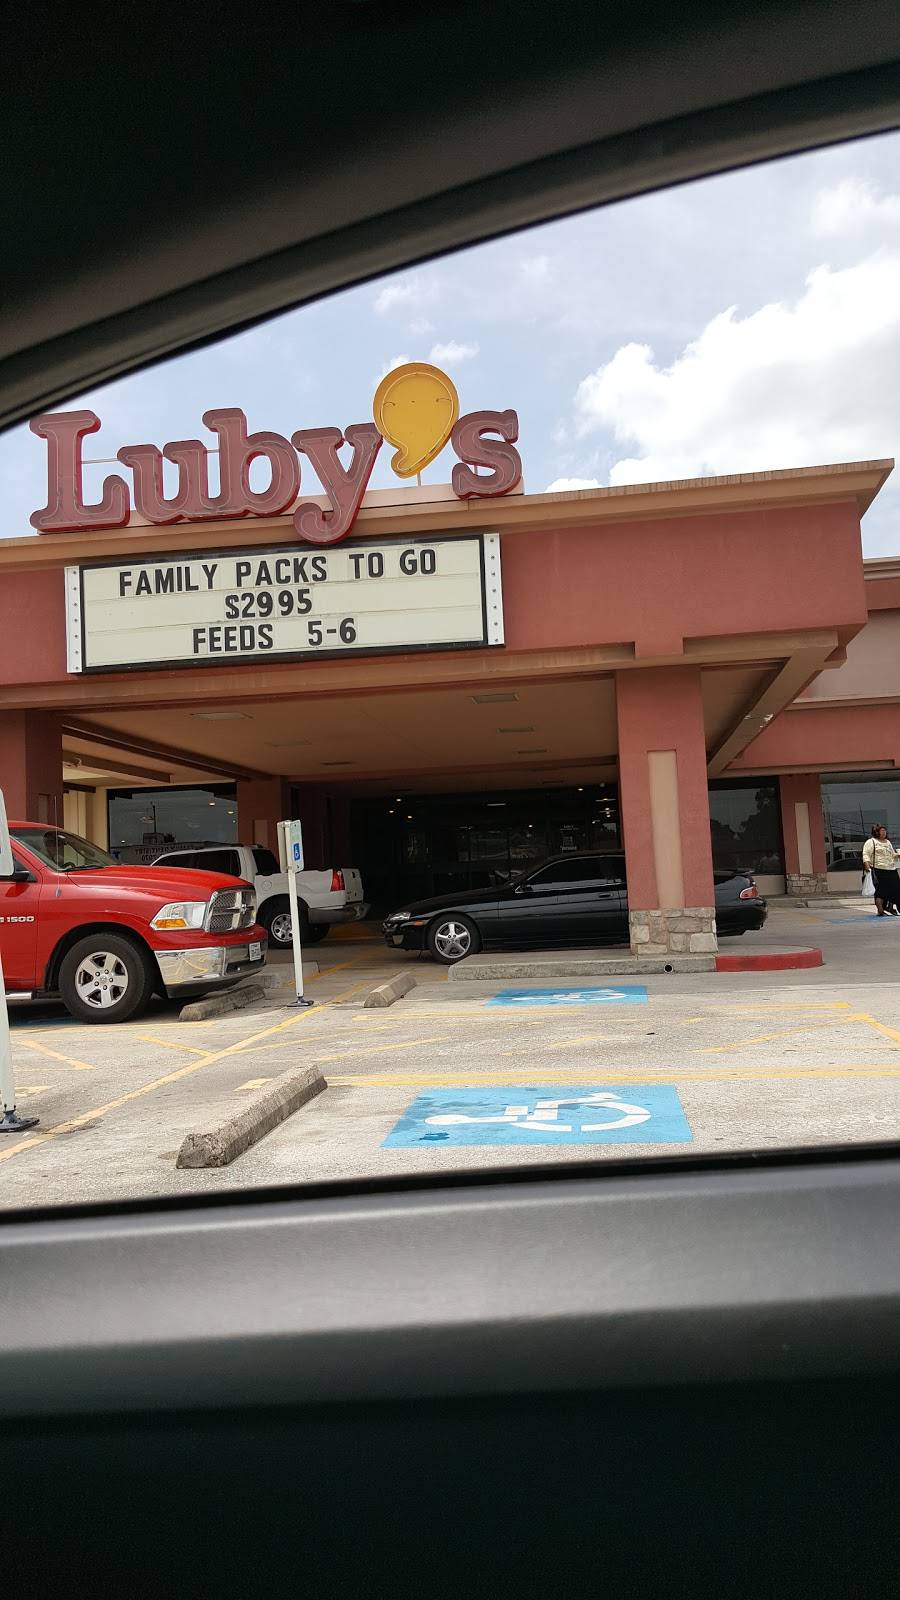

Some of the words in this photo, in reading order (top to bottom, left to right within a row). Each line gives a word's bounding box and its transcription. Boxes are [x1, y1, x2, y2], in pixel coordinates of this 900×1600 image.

[29, 361, 523, 545] Luby's
[119, 563, 218, 597] FAMILY
[235, 555, 327, 588] PACKS
[348, 552, 384, 580] TO
[399, 548, 436, 576] GO
[192, 623, 274, 654] FEEDS
[307, 617, 357, 647] 5-6
[6, 915, 35, 923] 1500
